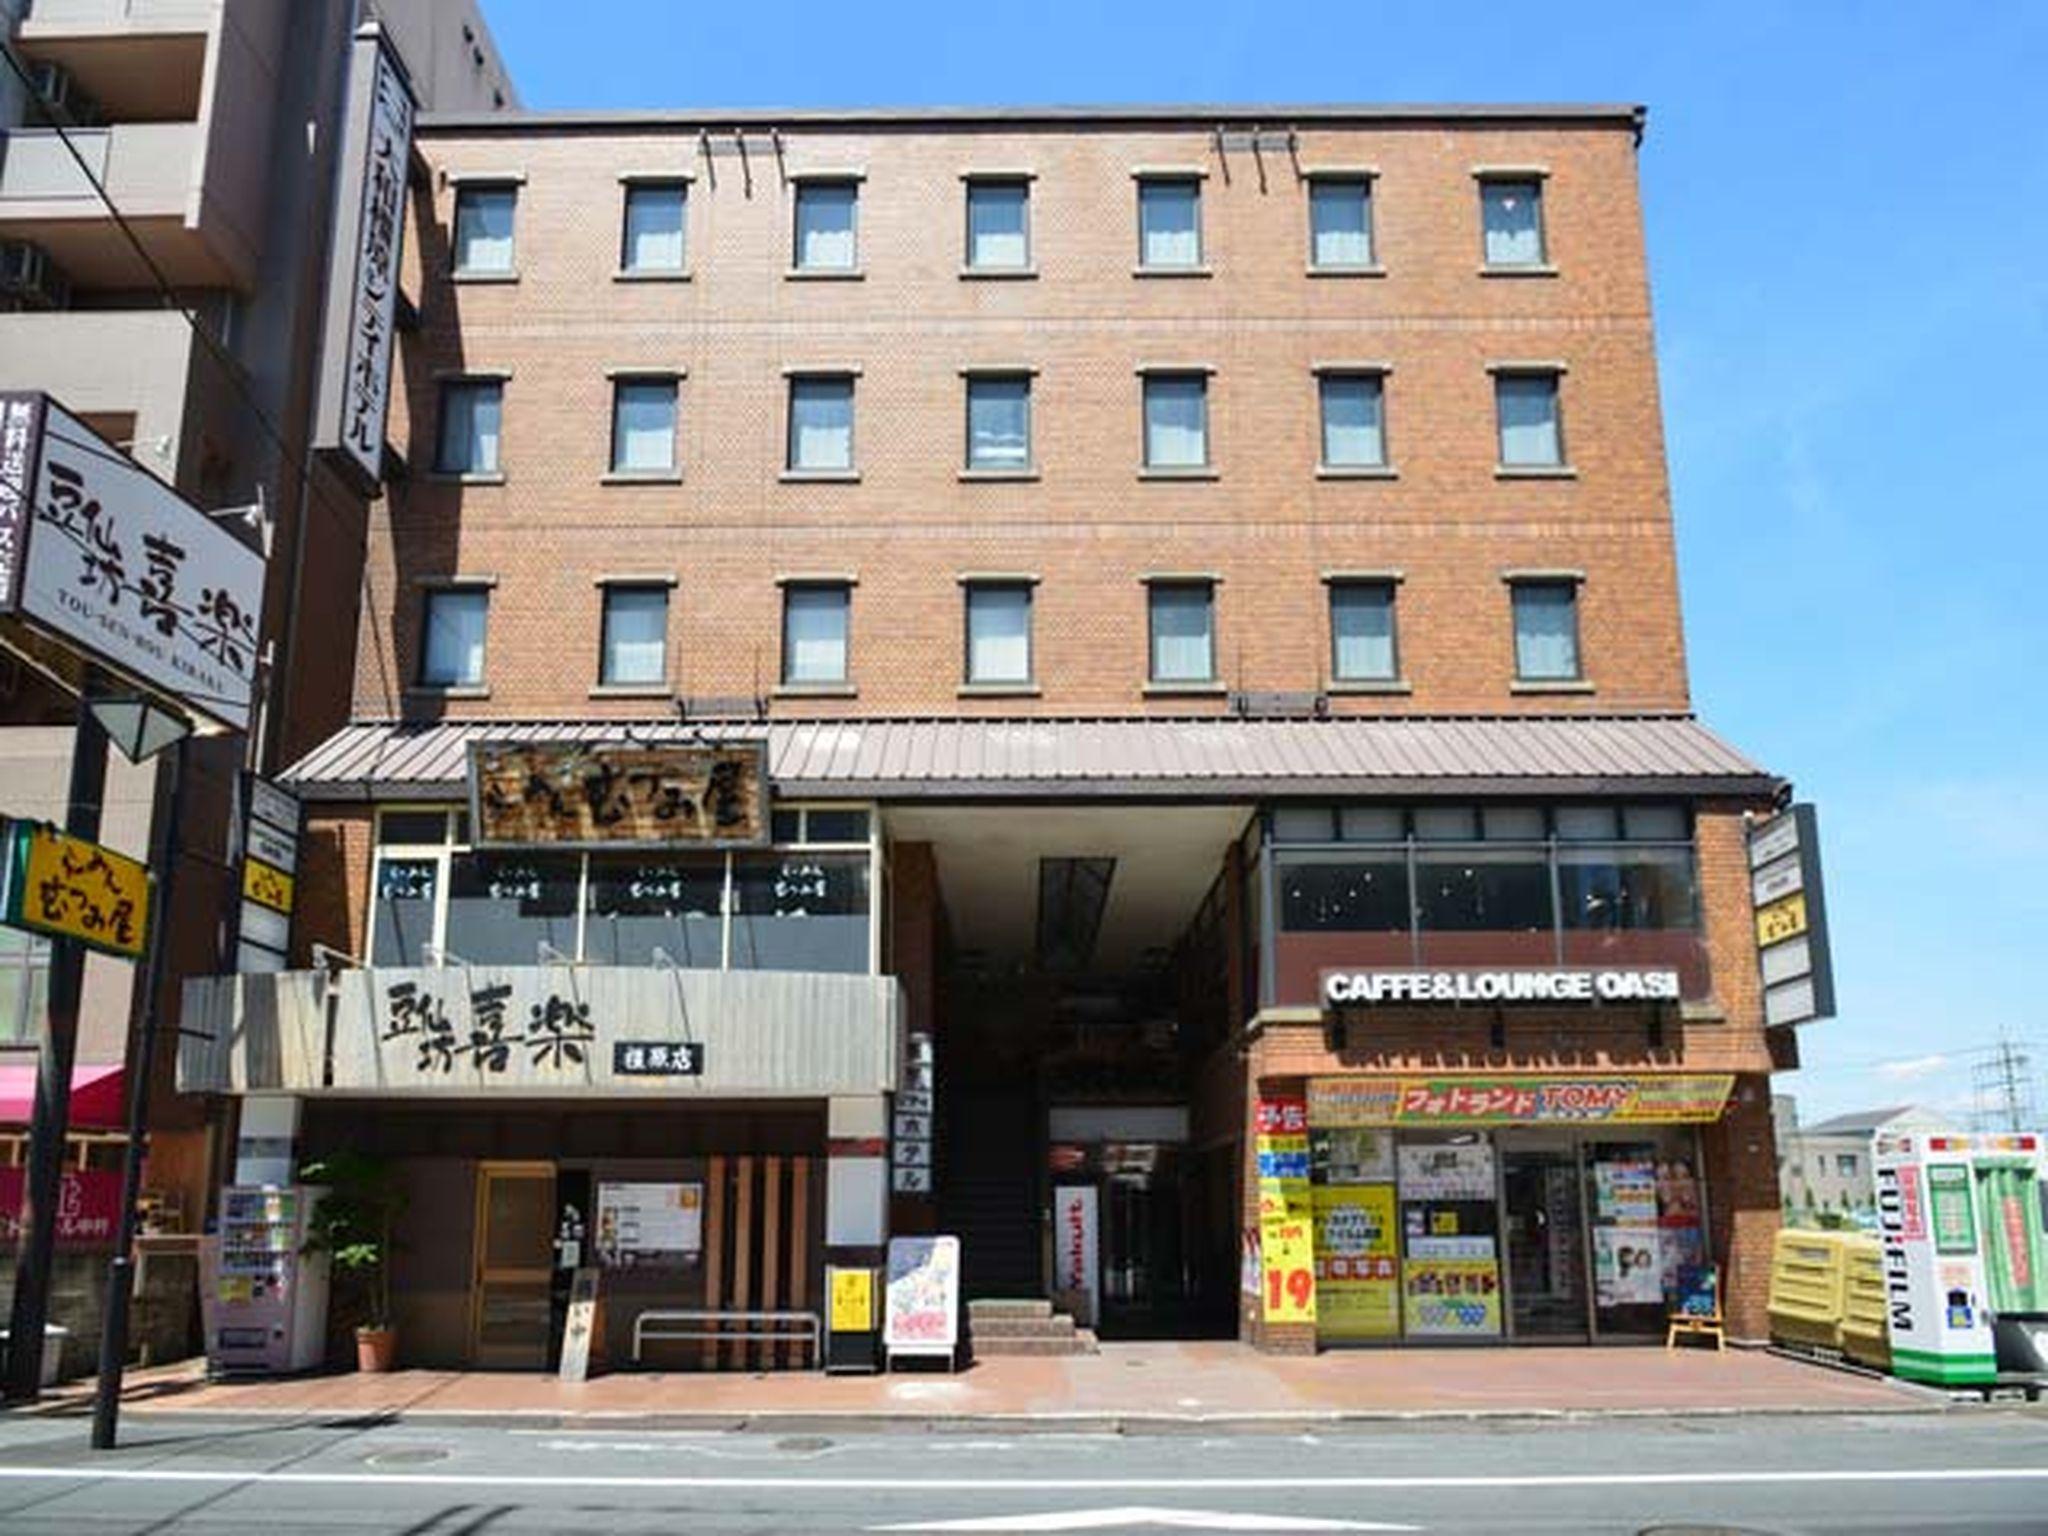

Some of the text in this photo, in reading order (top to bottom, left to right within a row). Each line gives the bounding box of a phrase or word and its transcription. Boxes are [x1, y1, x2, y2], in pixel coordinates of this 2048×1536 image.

[1326, 972, 1594, 1001] CAFFE&LOUNGE
[1543, 1085, 1636, 1112] TOMY
[1877, 1168, 1914, 1332] FUJIFILM
[1267, 1268, 1312, 1310] 19
